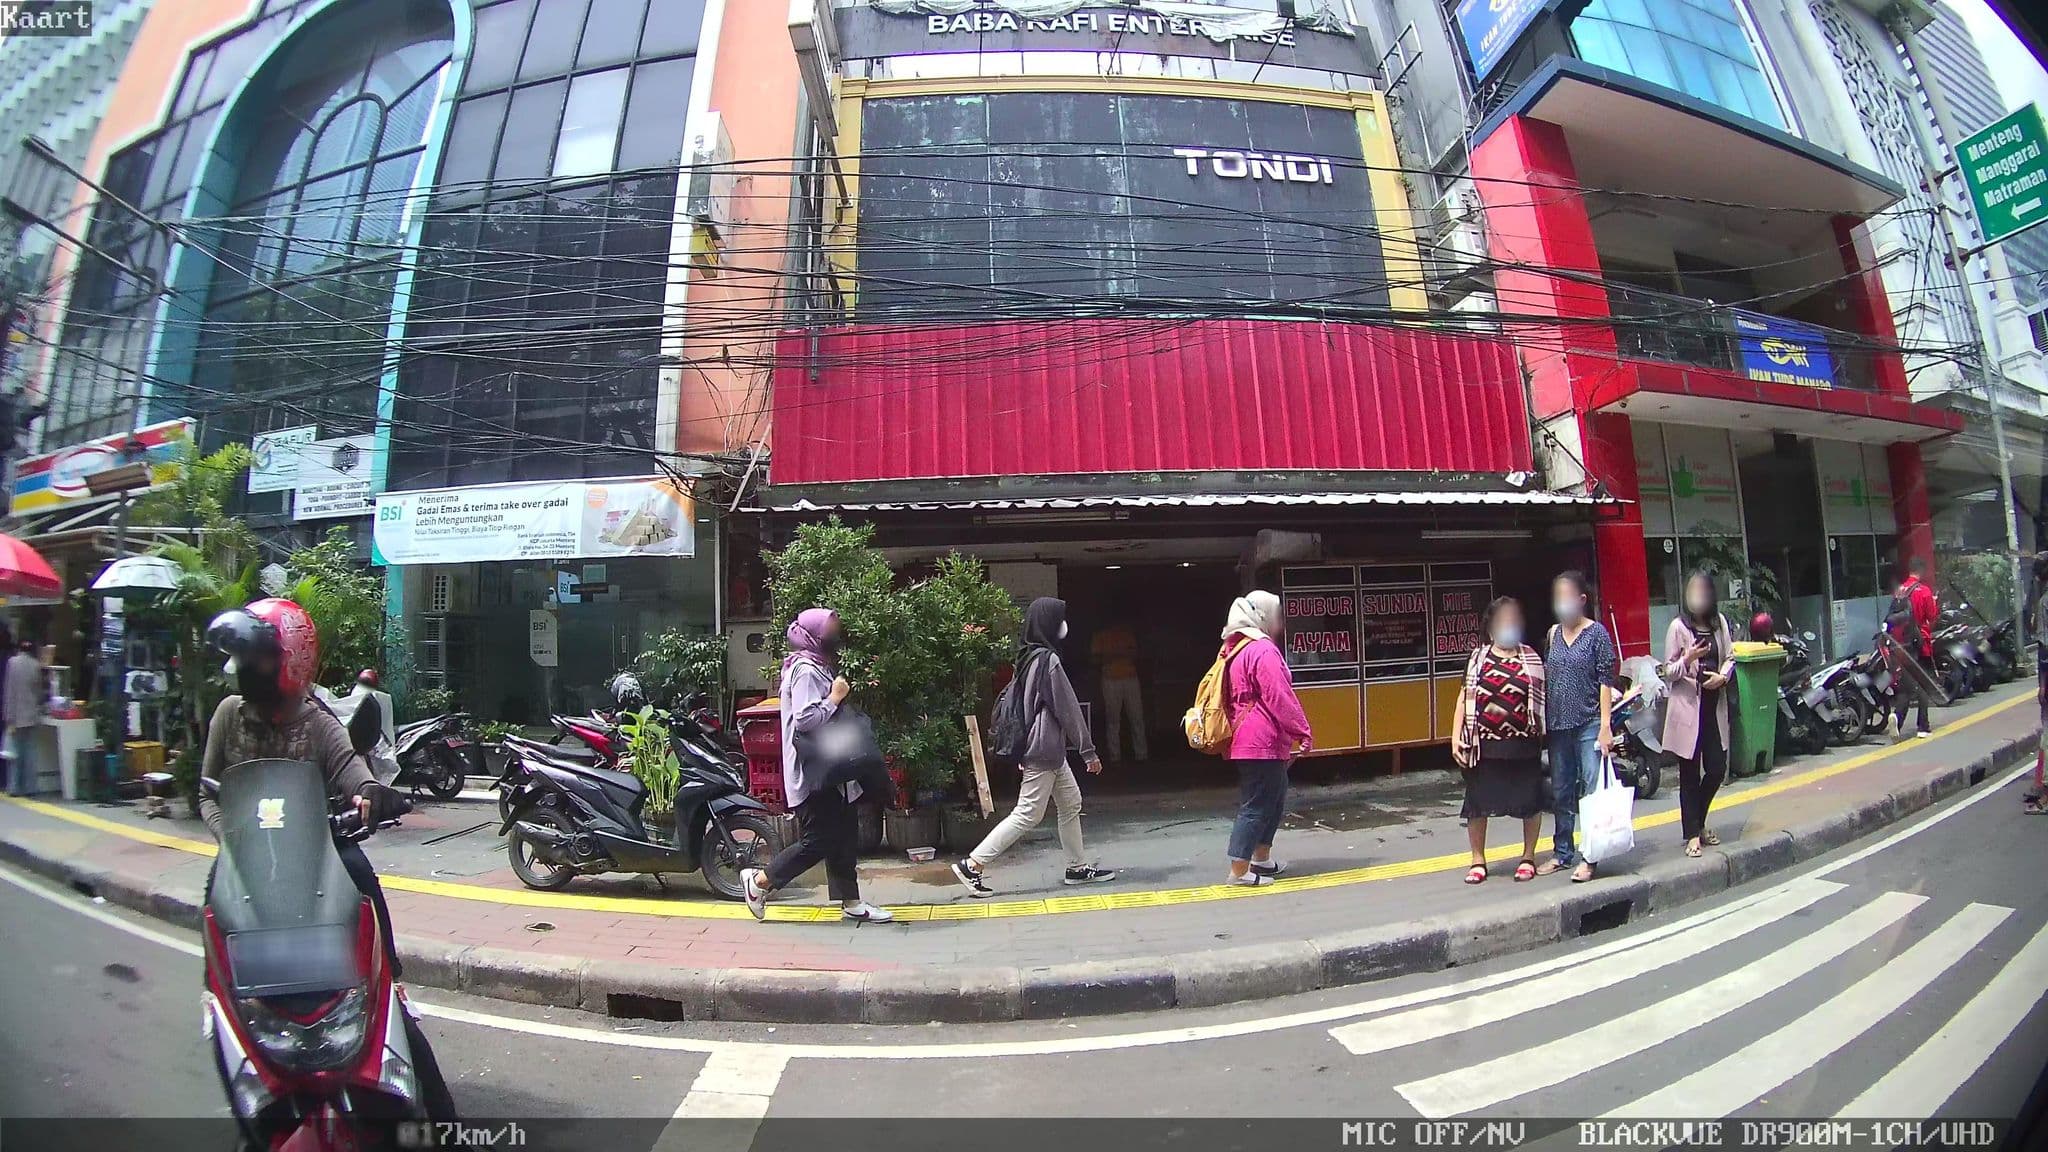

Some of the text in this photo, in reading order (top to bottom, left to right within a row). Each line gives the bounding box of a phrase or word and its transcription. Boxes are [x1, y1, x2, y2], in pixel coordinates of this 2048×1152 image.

[928, 14, 1018, 34] BABA
[1108, 14, 1296, 46] ENTERSE
[1967, 123, 2023, 162] Menteng
[1173, 149, 1333, 184] TONDI
[1975, 140, 2041, 185] Manggarai
[1983, 168, 2048, 208] Matraman
[417, 498, 569, 515] Gadai Emas & terima take over gadai
[419, 495, 459, 504] Menerima
[380, 506, 402, 521] BSI
[416, 513, 504, 526] Lebih Menguntungkan
[560, 583, 569, 593] BSI
[1286, 597, 1353, 617] BUBUR
[1363, 593, 1427, 615] SUNDA
[1442, 593, 1472, 611] MIE
[533, 622, 546, 631] BSI
[1436, 612, 1480, 634] AYAM
[1293, 631, 1351, 653] AYAM
[1436, 633, 1480, 654] BAKS
